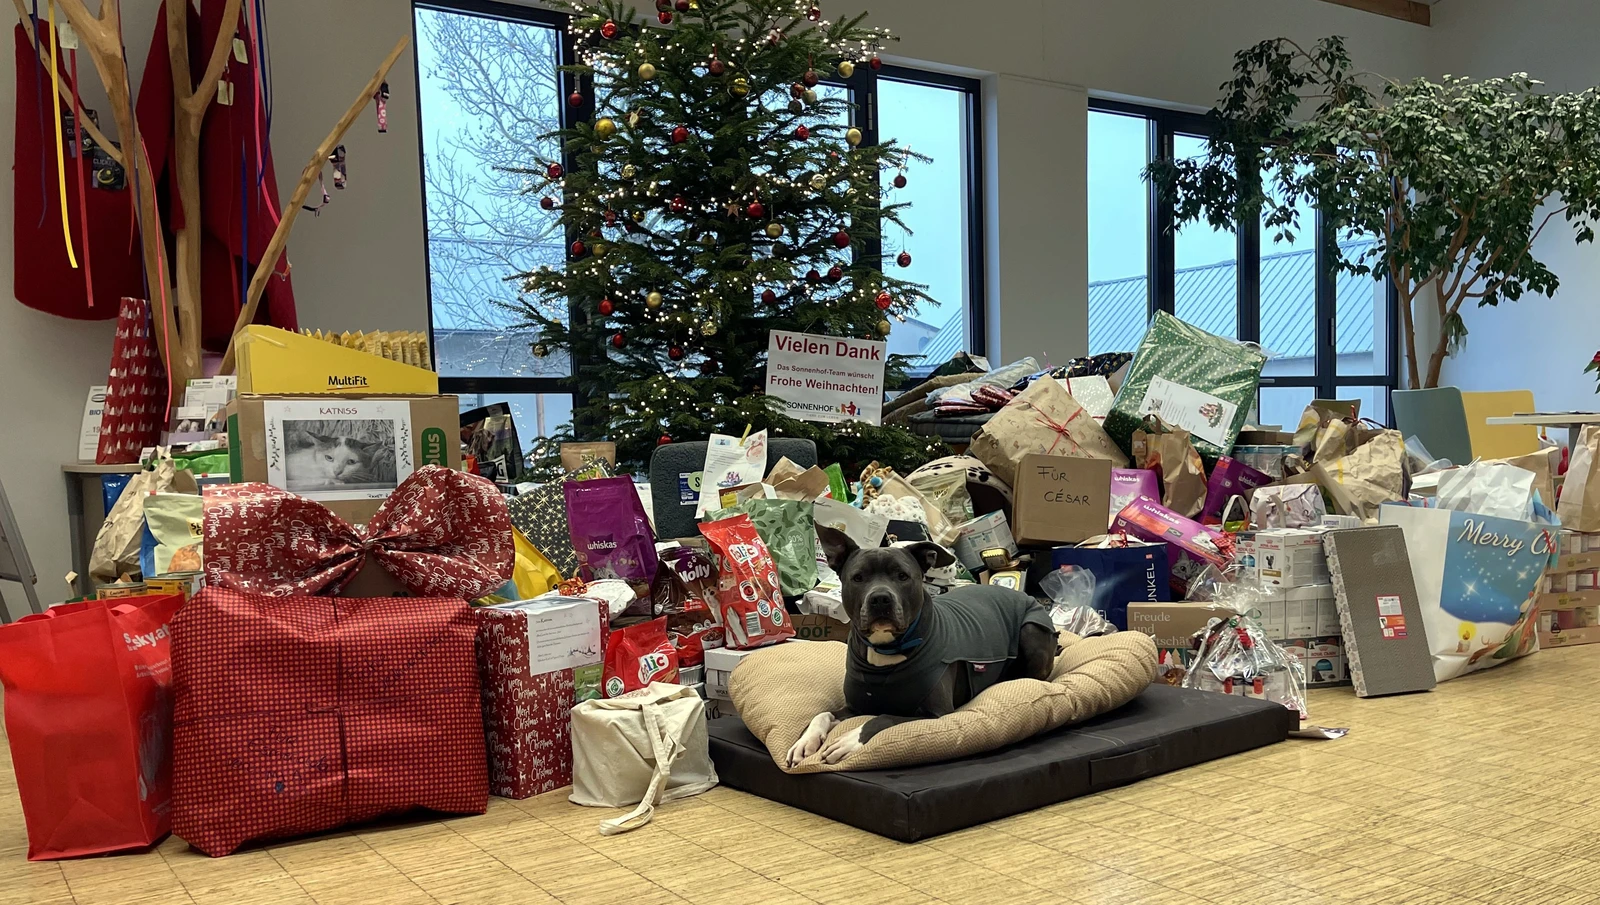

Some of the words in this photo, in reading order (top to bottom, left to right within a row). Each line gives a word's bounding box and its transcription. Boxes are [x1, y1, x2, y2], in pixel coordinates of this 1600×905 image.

[775, 335, 829, 355] Vielen
[836, 341, 880, 360] Dank
[791, 365, 846, 377] Sonnenhof-Team
[847, 371, 874, 379] wünscht
[328, 375, 368, 386] MultiFit
[770, 375, 802, 387] Frohe
[806, 378, 879, 394] Weihnachten!
[319, 407, 358, 415] KATNISS
[786, 401, 834, 412] SONNENHOF
[1037, 465, 1069, 482] FÜR
[1044, 488, 1090, 506] CÉSAR
[1143, 504, 1182, 525] whiskas
[1457, 518, 1524, 556] Merry
[587, 540, 617, 550] whiskas
[1133, 611, 1171, 622] Freude
[1133, 624, 1155, 634] und
[514, 717, 538, 730] Christmas
